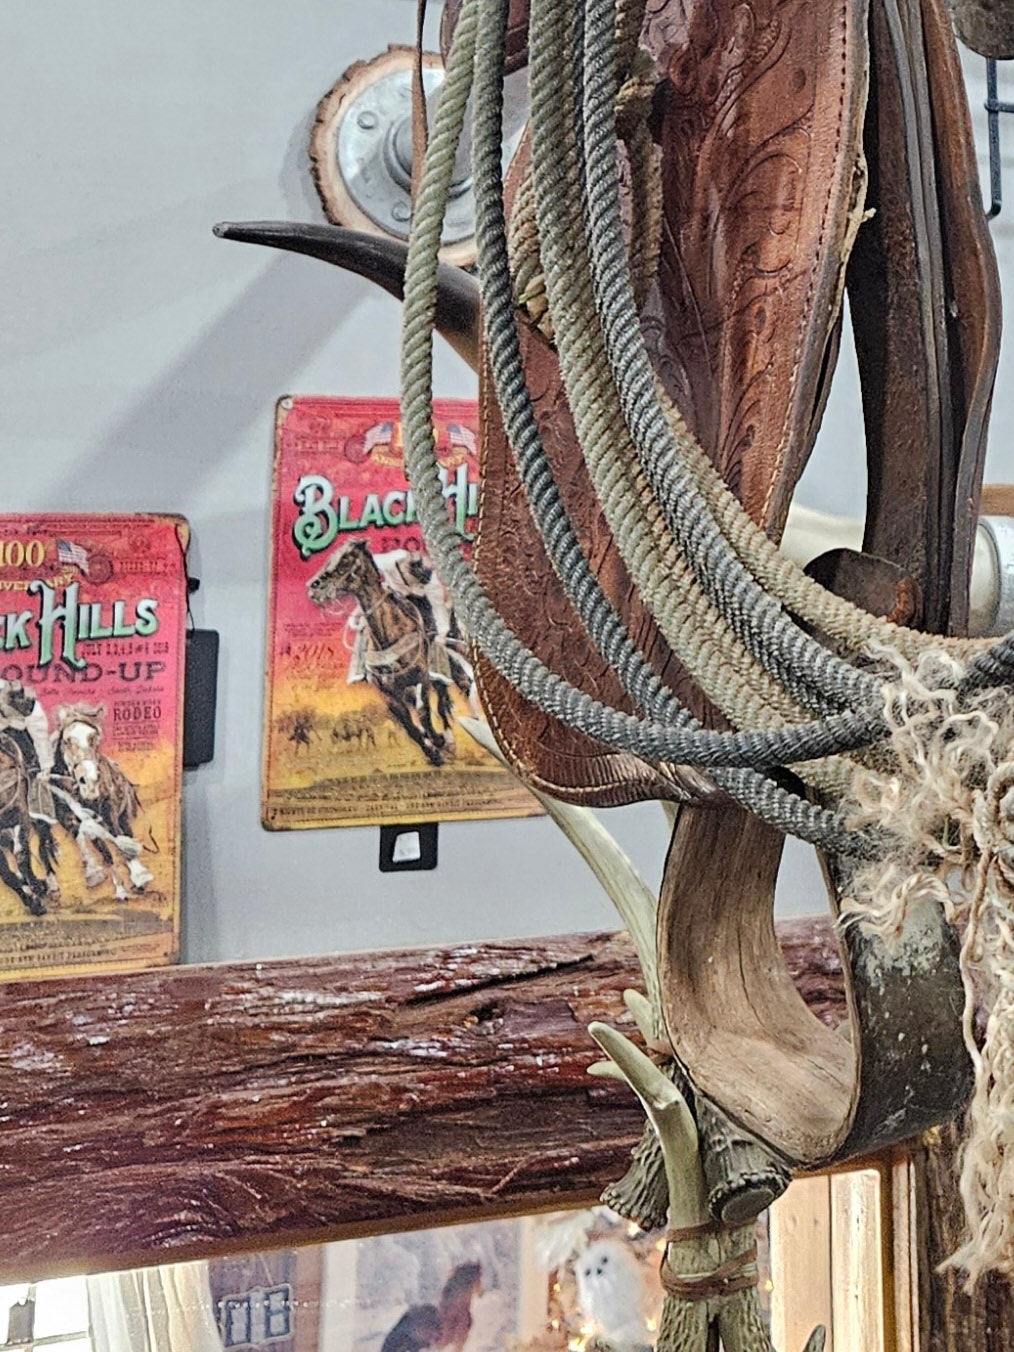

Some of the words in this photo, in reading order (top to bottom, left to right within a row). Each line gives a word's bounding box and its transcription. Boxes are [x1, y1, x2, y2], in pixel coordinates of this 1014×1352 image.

[0, 540, 45, 568] 100
[29, 579, 160, 669] HILLS
[113, 706, 162, 721] RODEO
